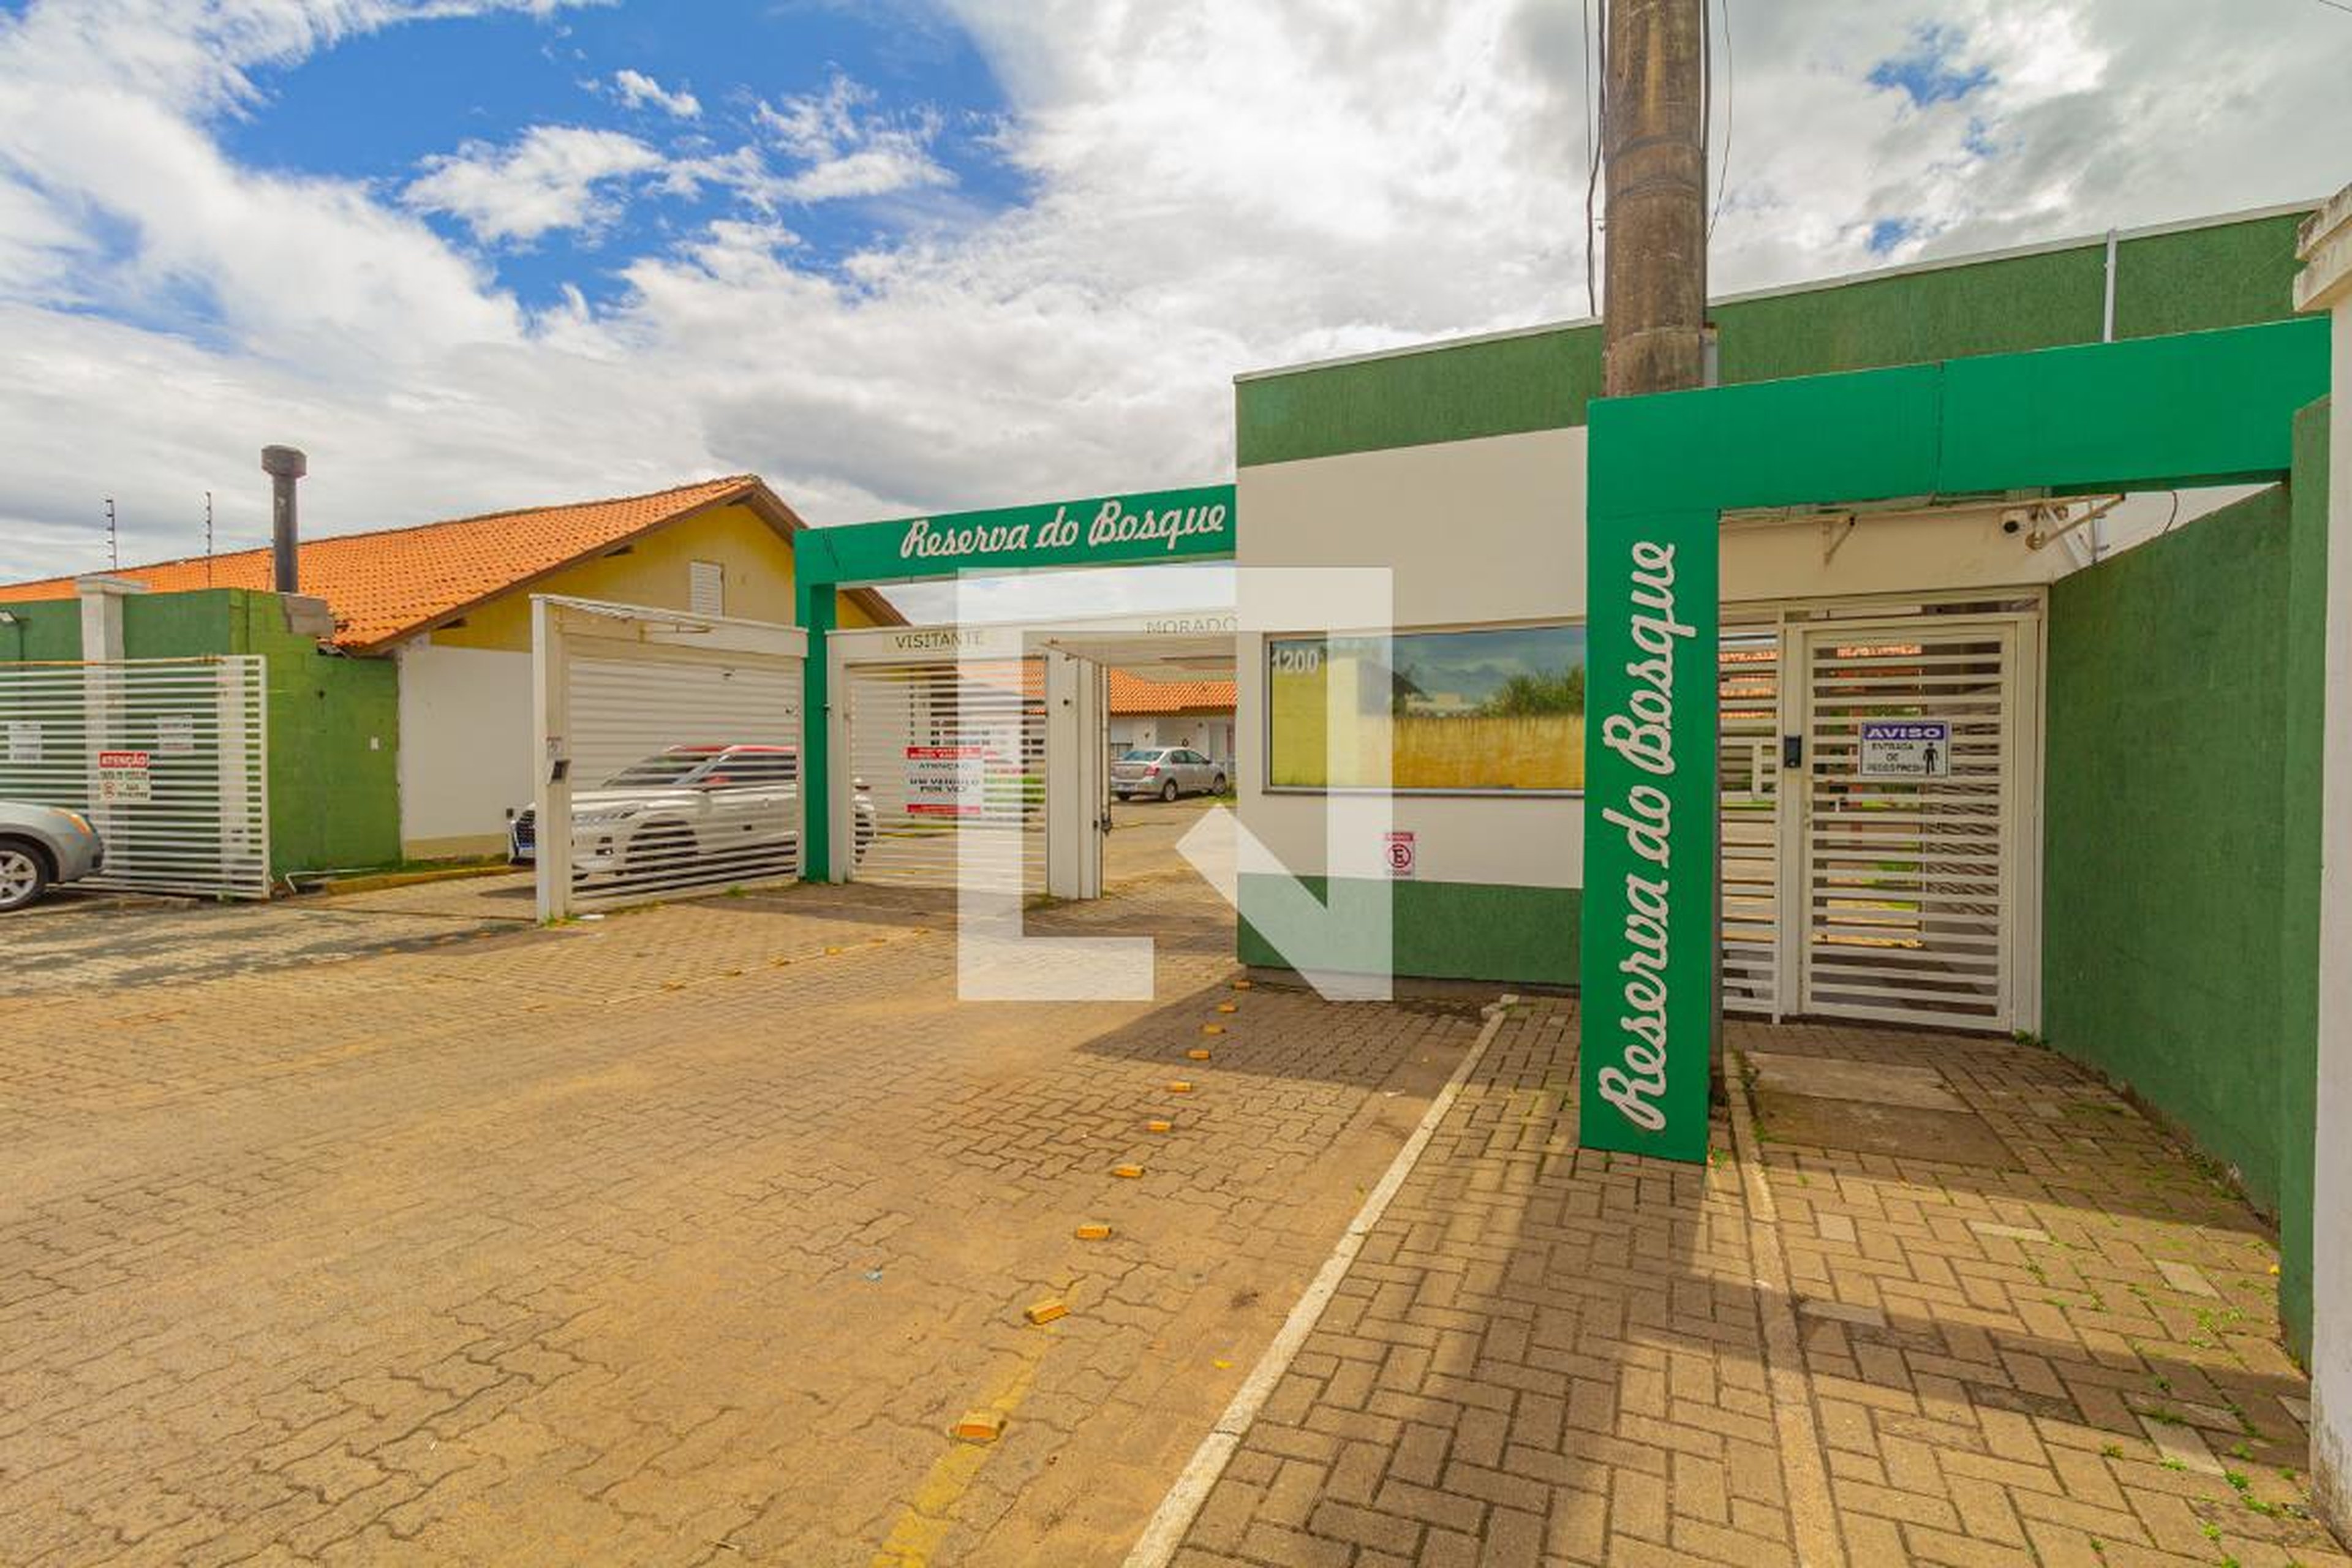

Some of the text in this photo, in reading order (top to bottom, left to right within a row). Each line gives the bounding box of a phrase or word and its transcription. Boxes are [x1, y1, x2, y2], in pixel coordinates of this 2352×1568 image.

[902, 500, 1226, 558] Reserva do Bosque
[1272, 650, 1319, 673] 1200
[1868, 727, 1941, 737] AVISO
[1597, 540, 1697, 1130] Reserva do Bosque
